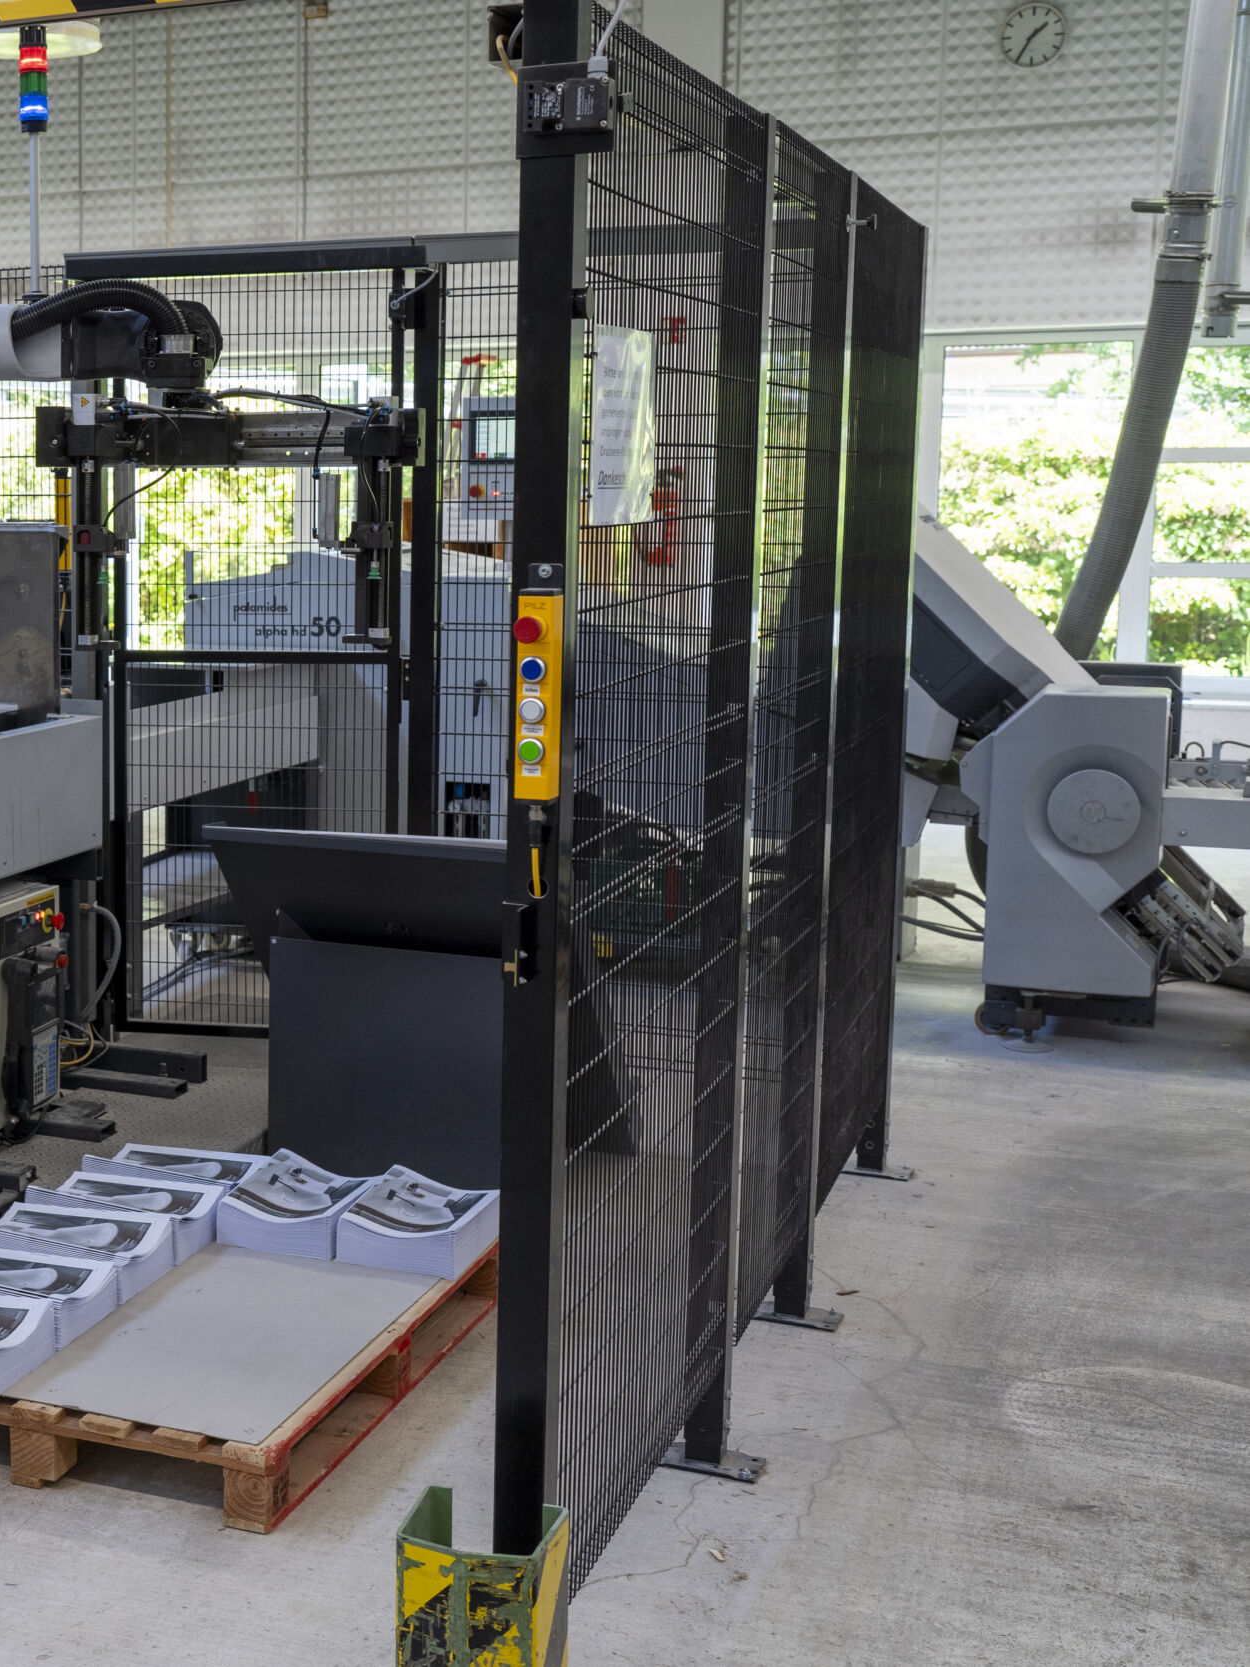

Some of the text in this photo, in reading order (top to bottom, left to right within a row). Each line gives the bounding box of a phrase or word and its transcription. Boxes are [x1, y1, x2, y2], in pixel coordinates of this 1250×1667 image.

[233, 595, 288, 621] palamides
[524, 601, 547, 610] PILZ
[310, 616, 341, 637] 50
